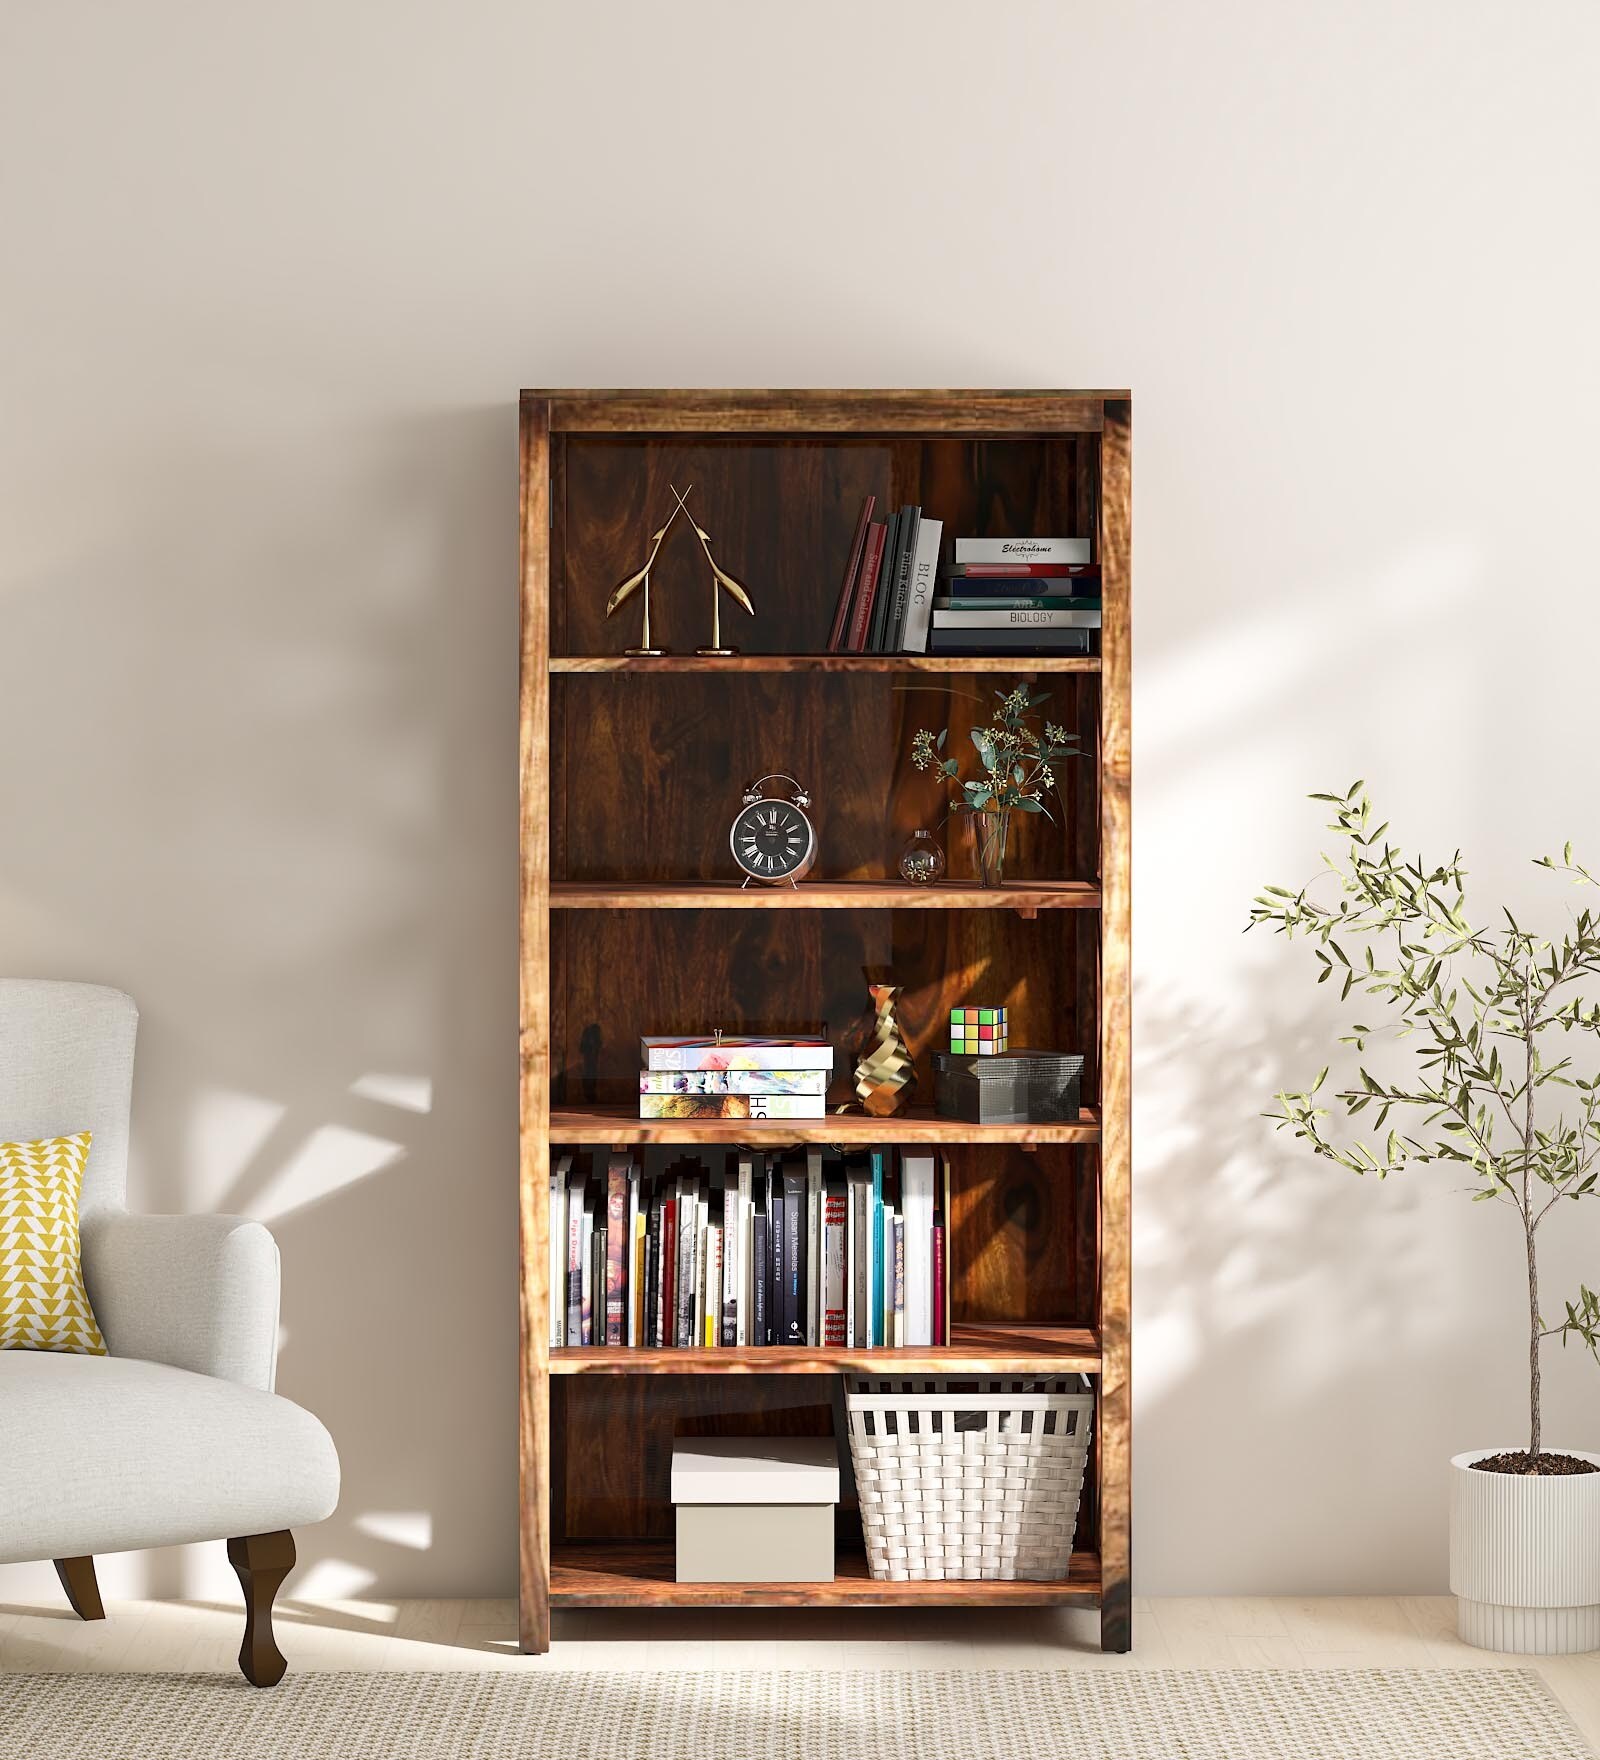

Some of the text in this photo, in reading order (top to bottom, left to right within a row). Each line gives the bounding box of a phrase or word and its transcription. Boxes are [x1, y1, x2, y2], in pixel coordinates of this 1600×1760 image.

[1002, 544, 1052, 553] Electrohome
[864, 575, 873, 593] and
[894, 552, 912, 620] Film Kitchen
[914, 562, 930, 605] BLOG
[1010, 612, 1053, 623] BIOLOGY
[791, 1211, 799, 1235] Susan
